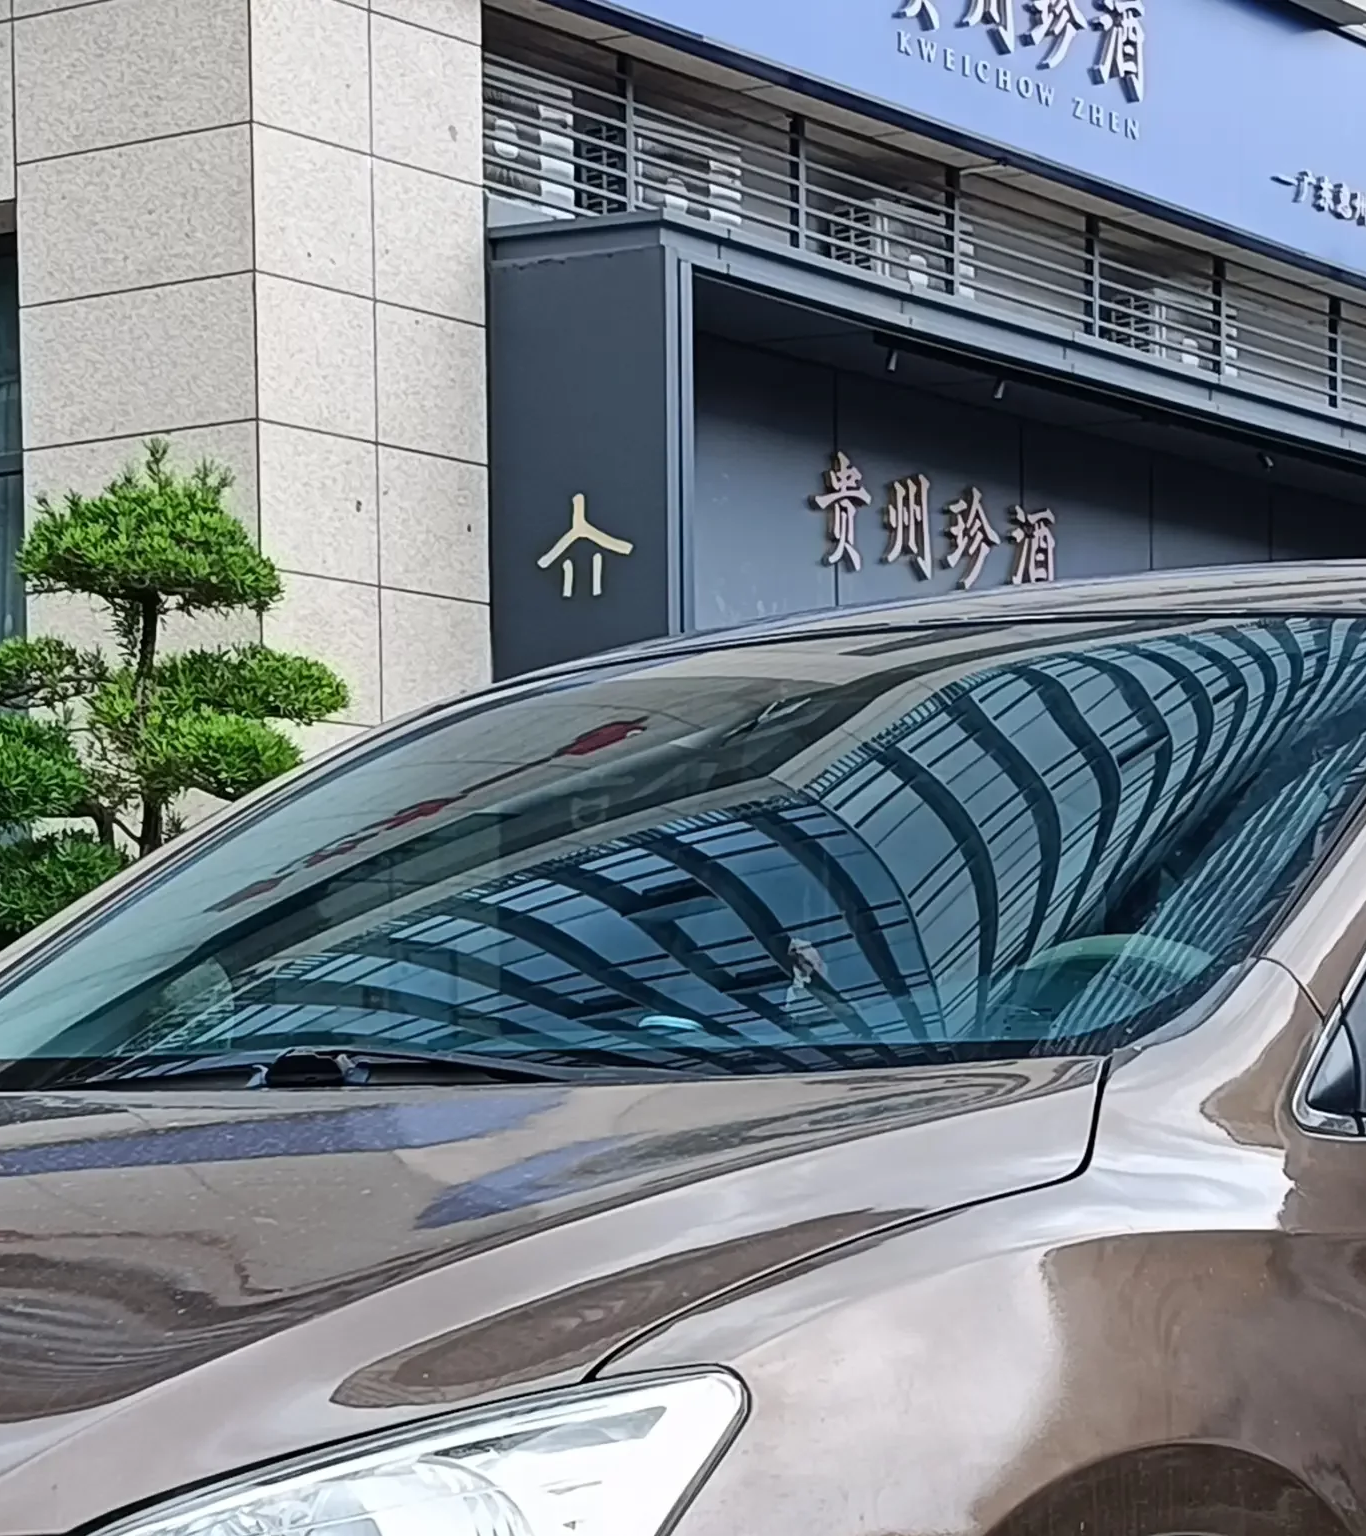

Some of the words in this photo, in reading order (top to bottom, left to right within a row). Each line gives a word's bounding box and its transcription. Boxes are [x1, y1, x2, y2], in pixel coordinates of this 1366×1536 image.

[896, 30, 1056, 107] KWEICHOW
[1071, 96, 1141, 141] ZHEN
[809, 450, 1058, 590] 贵州珍酒
